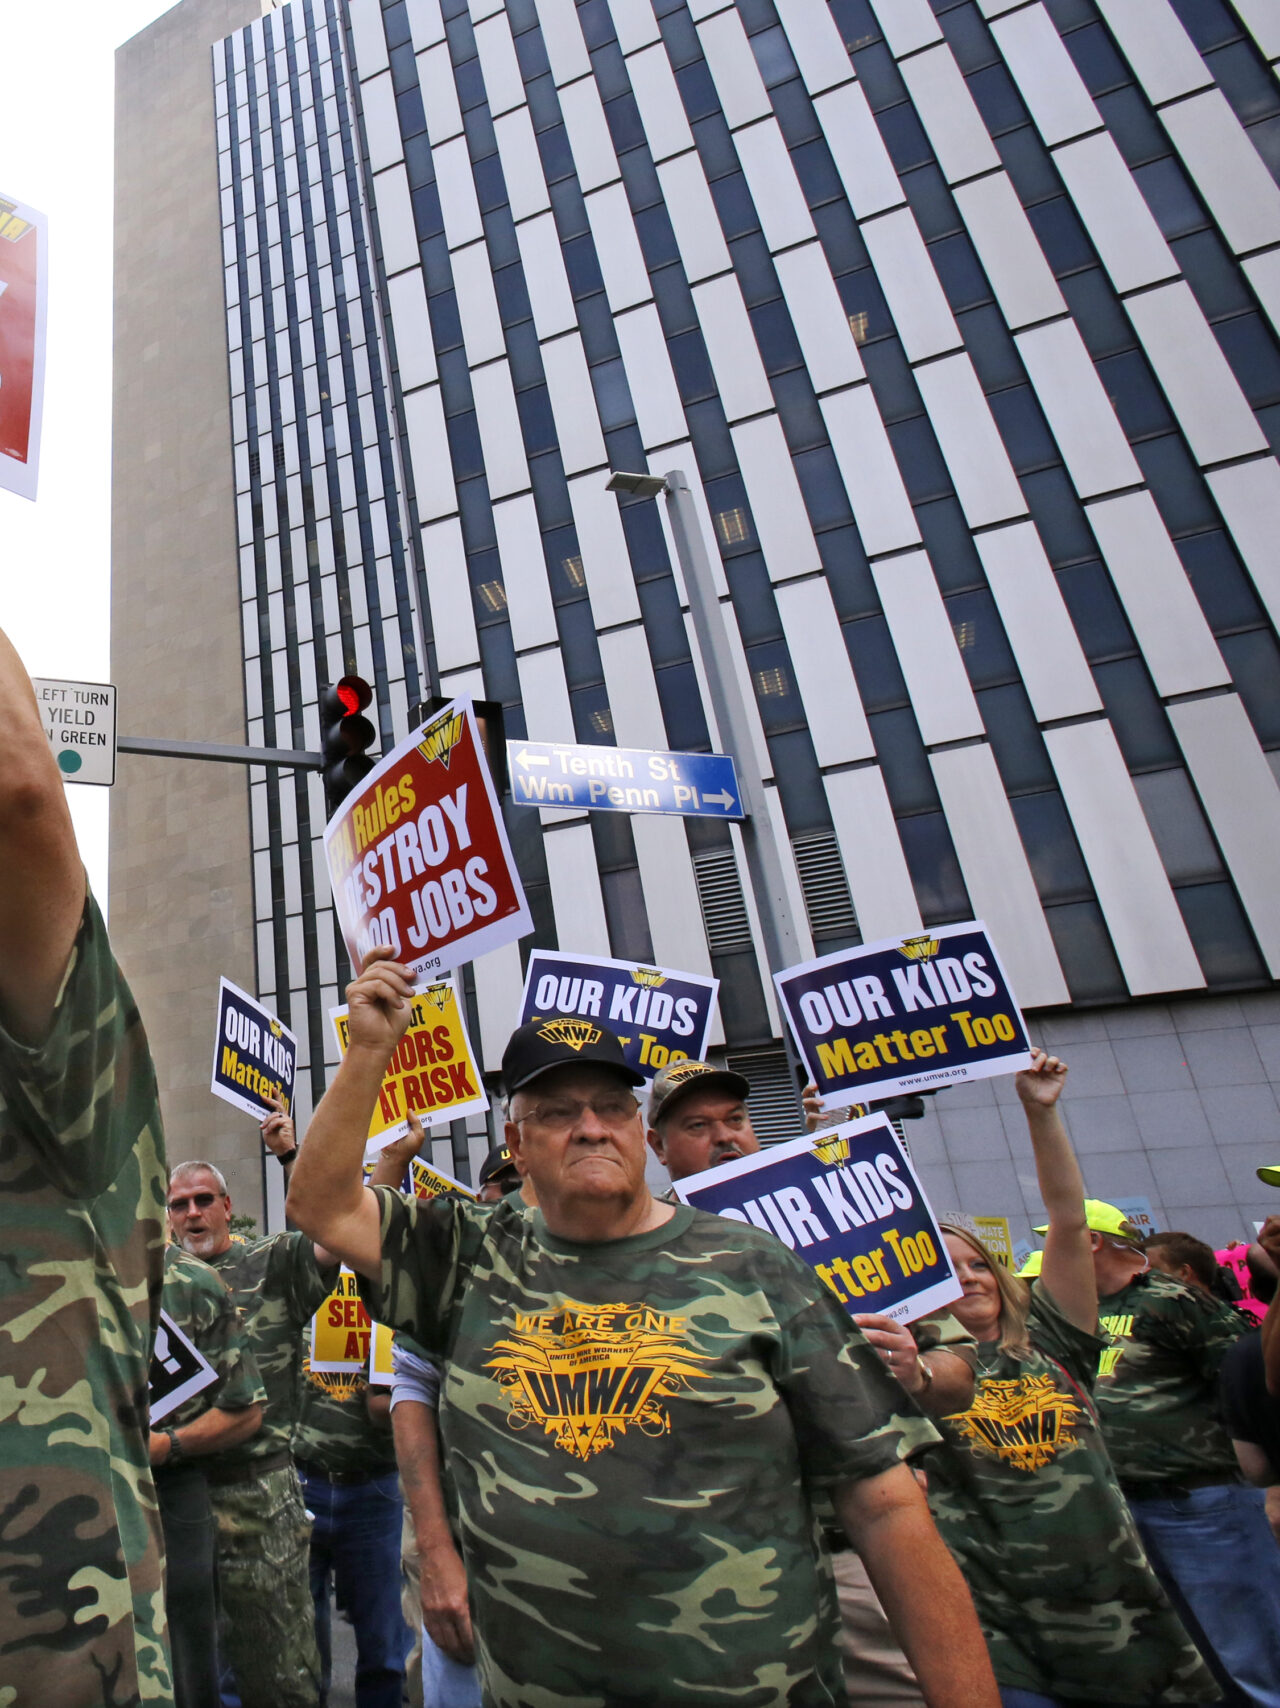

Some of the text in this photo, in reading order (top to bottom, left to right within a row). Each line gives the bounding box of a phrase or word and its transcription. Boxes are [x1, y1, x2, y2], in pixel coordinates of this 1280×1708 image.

[48, 707, 95, 726] YIELD
[74, 690, 109, 706] TURN
[61, 730, 106, 746] GREEN
[417, 712, 463, 764] UMWA
[553, 750, 681, 782] Tenth St
[518, 775, 701, 810] Wm Penn Pl
[326, 773, 417, 885] EPA Rules
[343, 782, 472, 930] DESTROY
[406, 856, 498, 949] JOBS
[534, 974, 698, 1036] OUR KIDS
[799, 952, 997, 1035] OUR KIDS
[225, 1005, 261, 1059] OUR
[263, 1030, 293, 1086] KIDS
[386, 1025, 455, 1077] IORS
[539, 1025, 600, 1043] UMWA
[815, 1010, 1016, 1080] Matter Too
[221, 1046, 275, 1099] Matter
[378, 1061, 477, 1125] AT RISK
[898, 1067, 968, 1087] www.umwa.org
[810, 1152, 914, 1234] KIDS
[980, 1226, 1005, 1239] MATE
[813, 1228, 939, 1305] tter Too
[515, 1310, 688, 1334] WE ARE ONE
[549, 1346, 635, 1361] UNITED MINE WORKERS
[569, 1353, 611, 1367] OF AMERICA
[524, 1366, 657, 1418] UMWA
[968, 1408, 1057, 1449] UMWA
